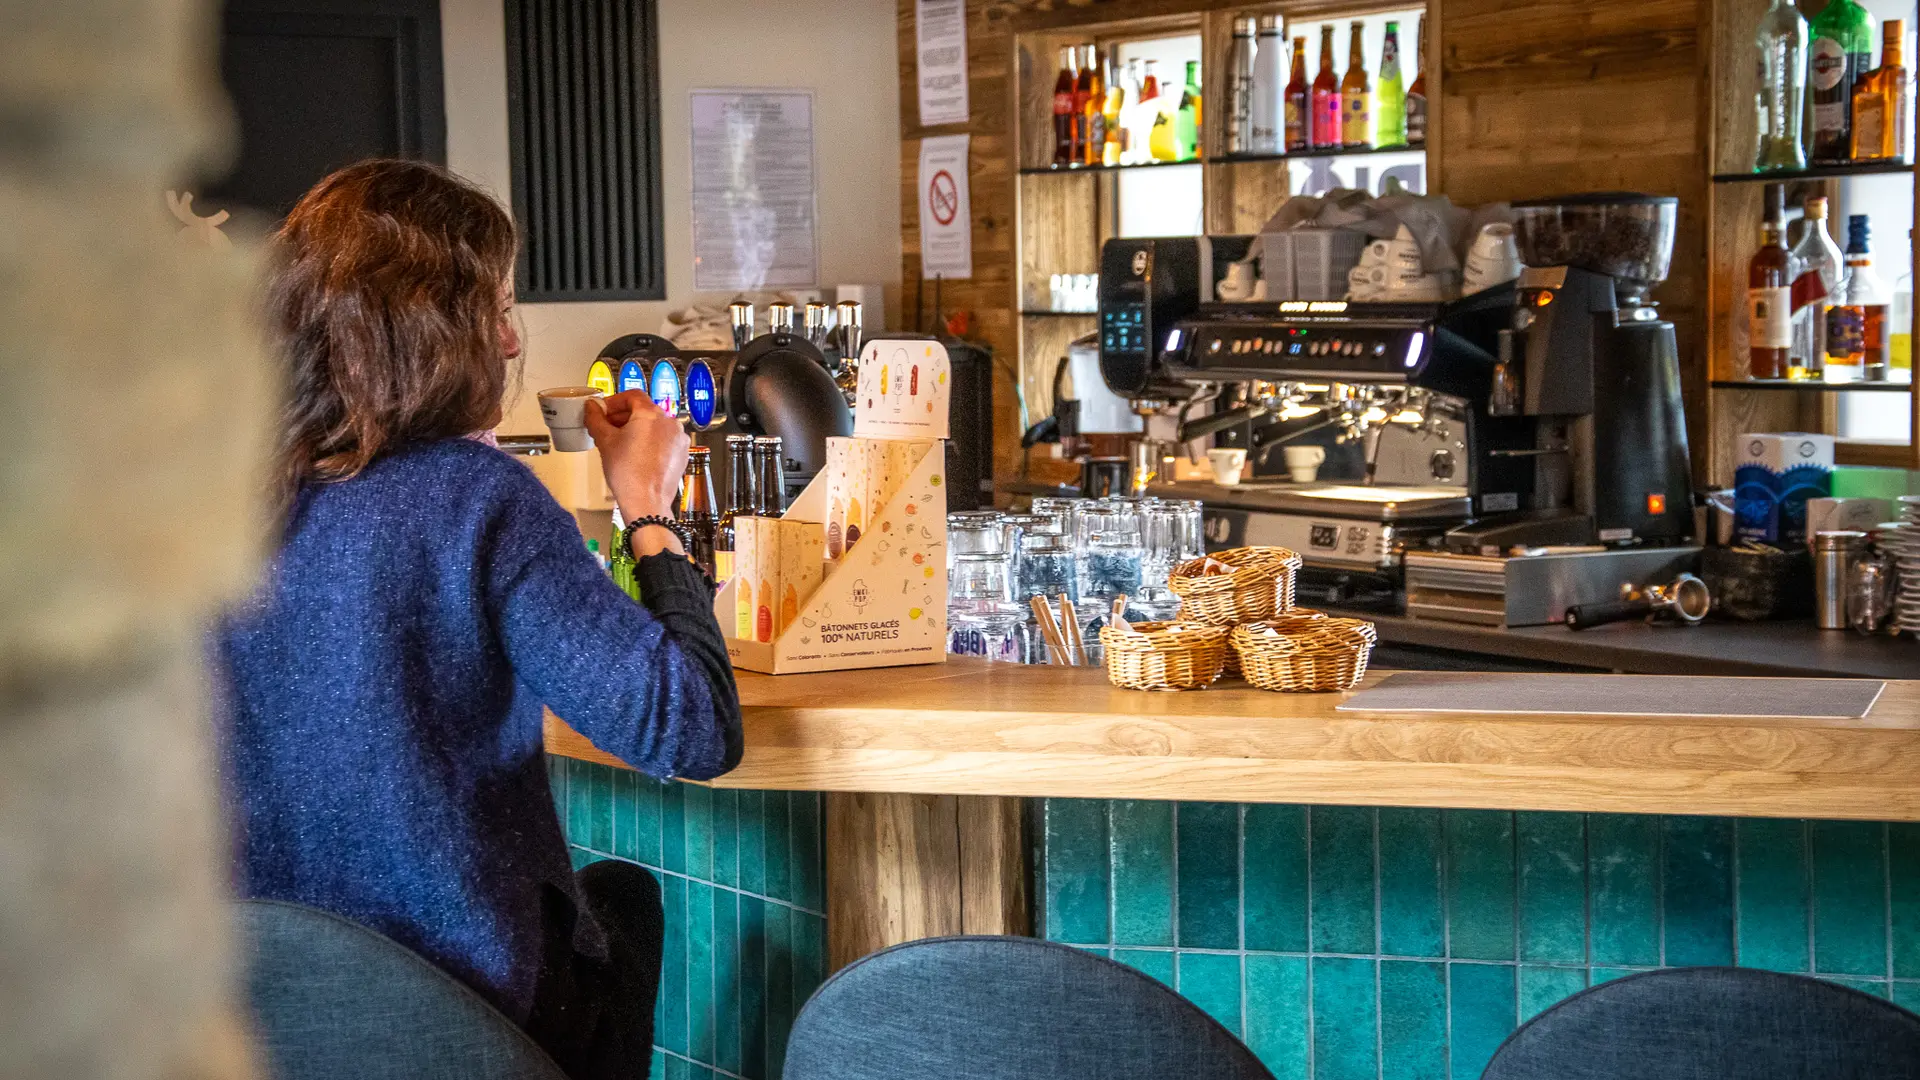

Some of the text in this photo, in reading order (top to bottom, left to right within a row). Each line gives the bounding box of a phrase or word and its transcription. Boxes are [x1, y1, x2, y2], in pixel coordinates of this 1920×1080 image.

[821, 620, 900, 633] BÂTONNETS GLACÉS
[821, 630, 899, 644] 100% NATURELS
